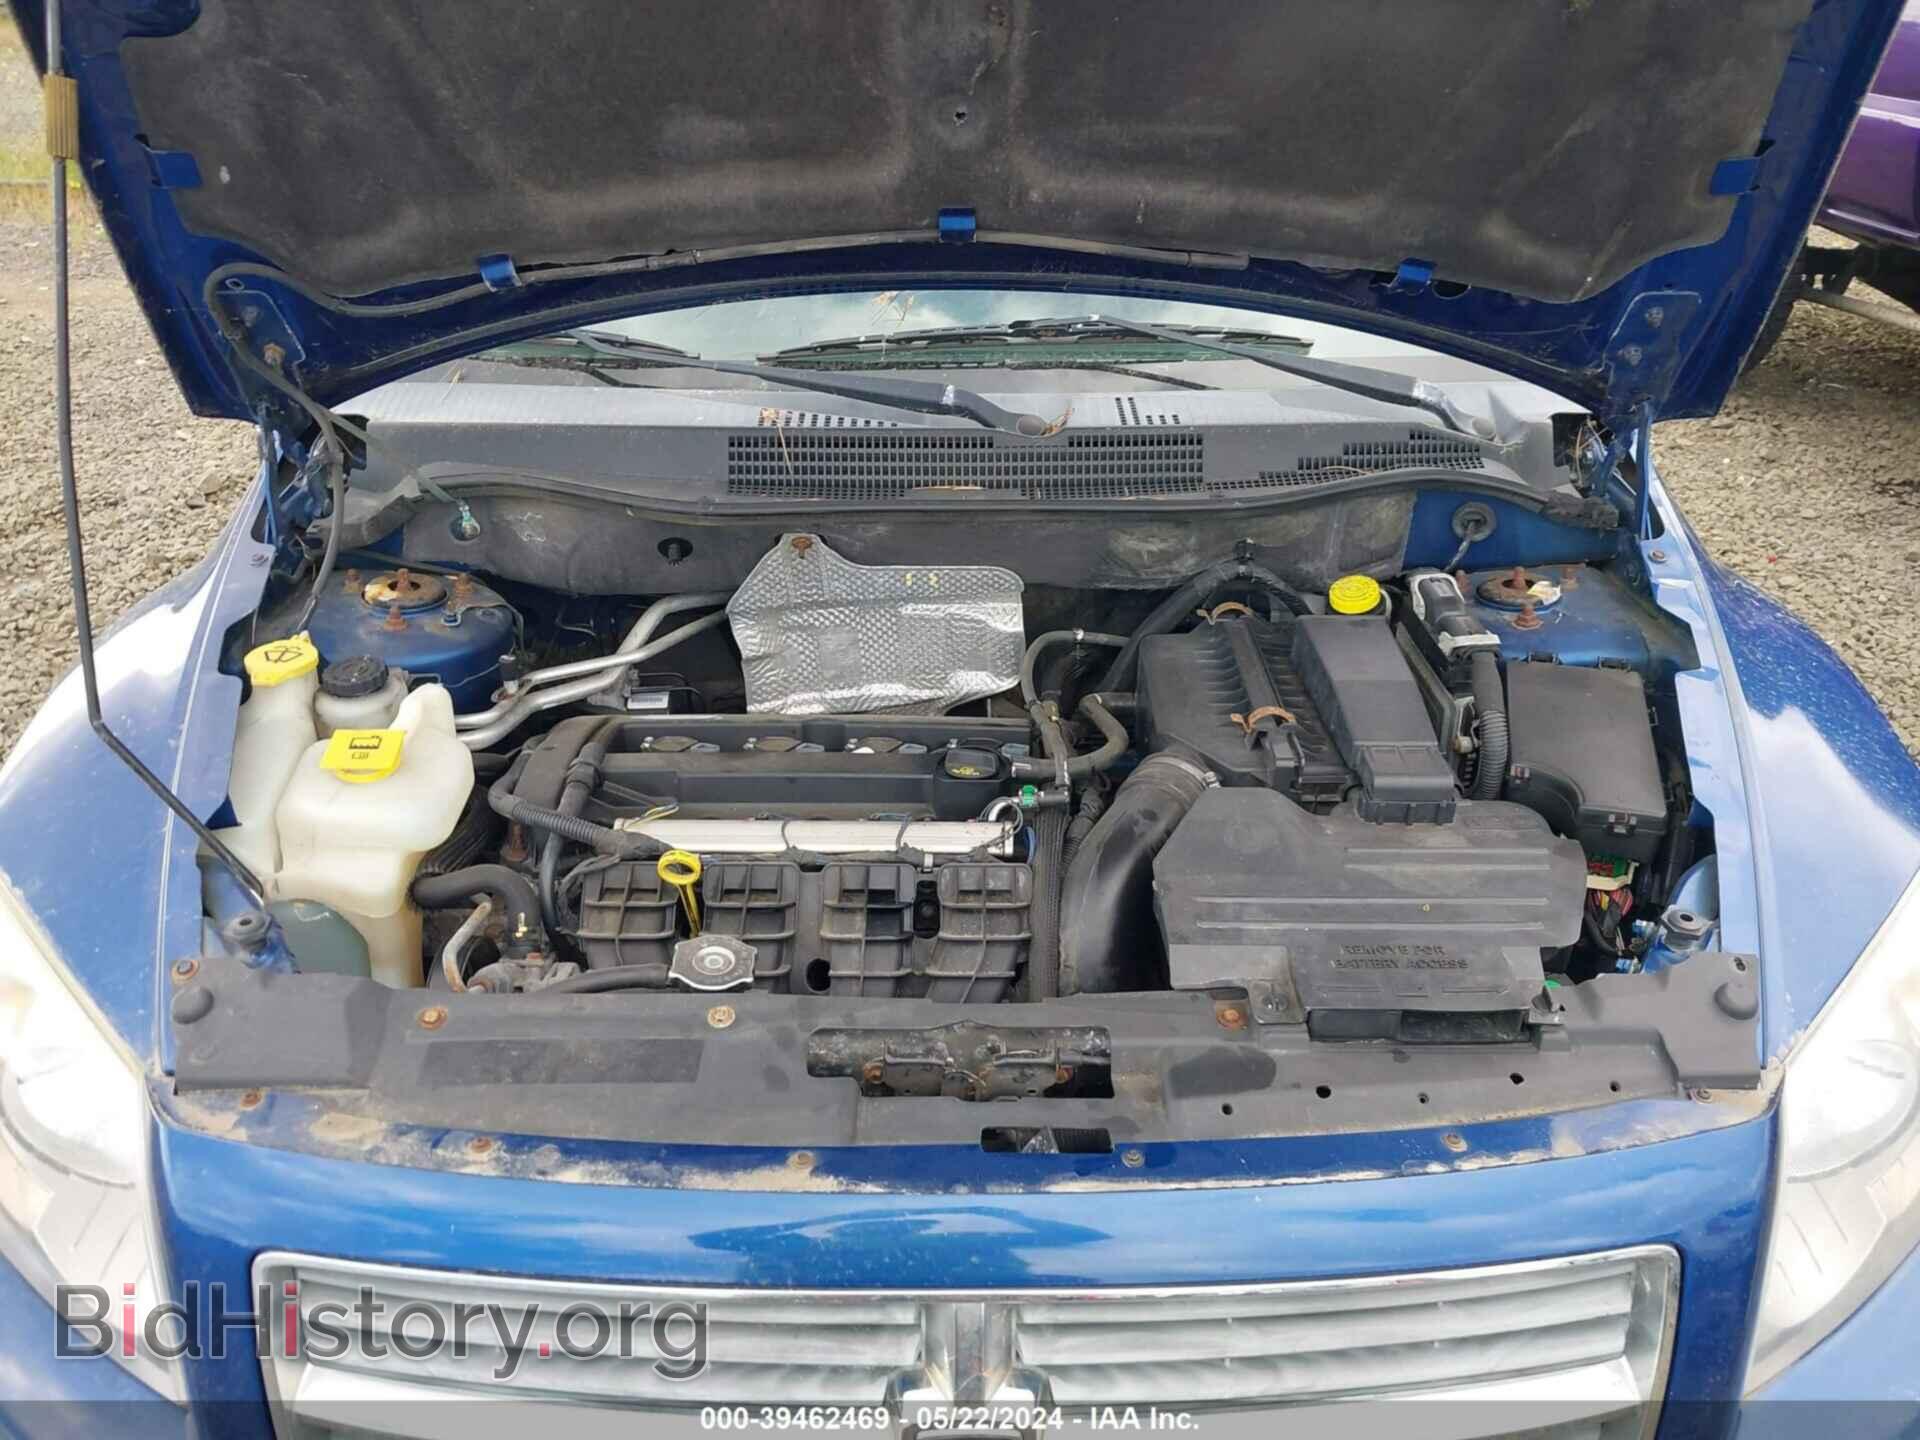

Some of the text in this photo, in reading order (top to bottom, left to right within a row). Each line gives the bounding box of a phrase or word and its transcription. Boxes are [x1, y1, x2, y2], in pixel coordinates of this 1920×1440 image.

[1338, 943, 1409, 956] REMOVE
[1329, 958, 1469, 969] BATTERY ACCESS
